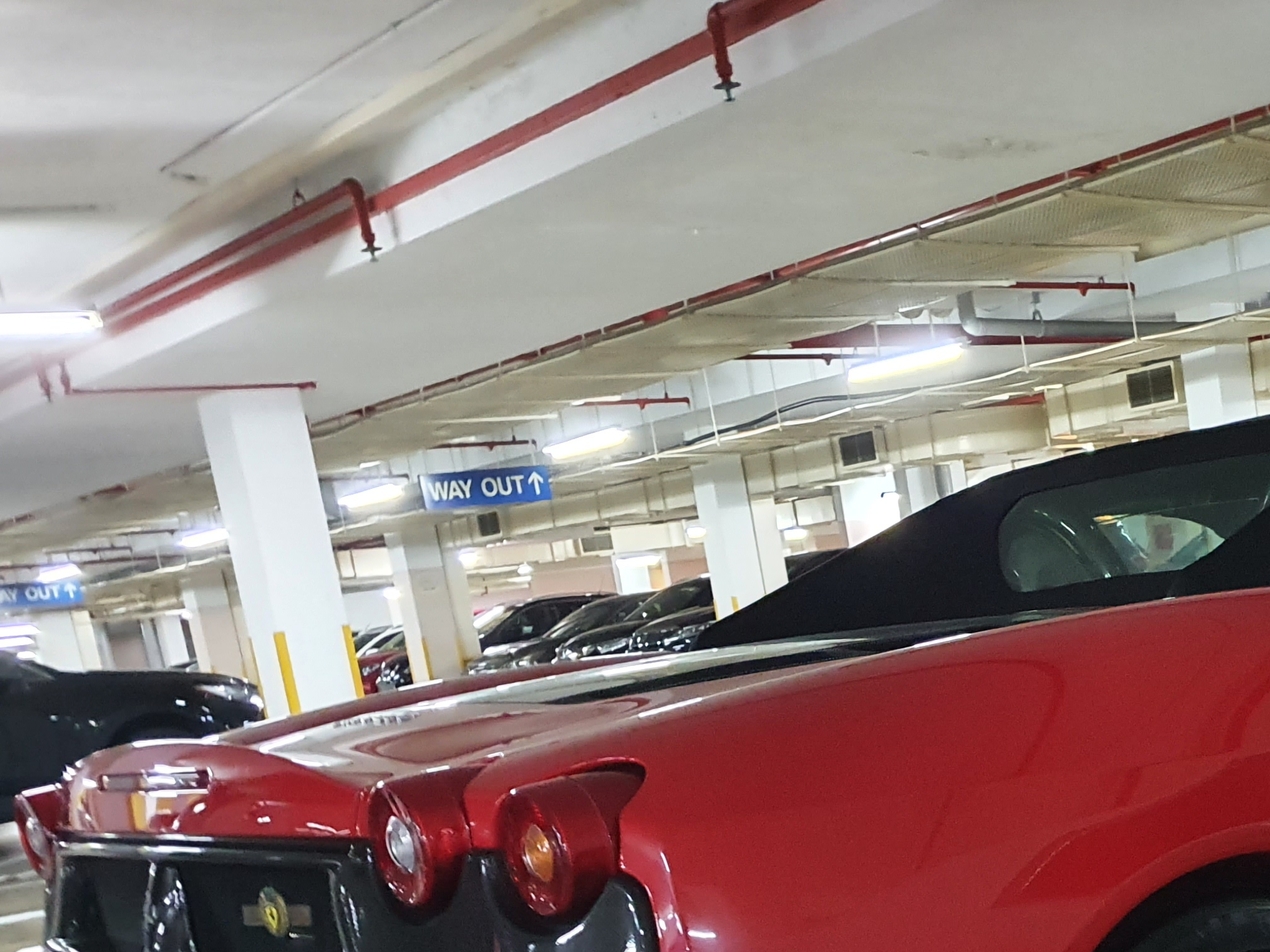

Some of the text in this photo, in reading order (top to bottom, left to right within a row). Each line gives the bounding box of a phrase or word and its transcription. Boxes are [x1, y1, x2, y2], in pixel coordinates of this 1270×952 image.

[427, 474, 525, 502] WAY OUT
[24, 583, 60, 602] OUT
